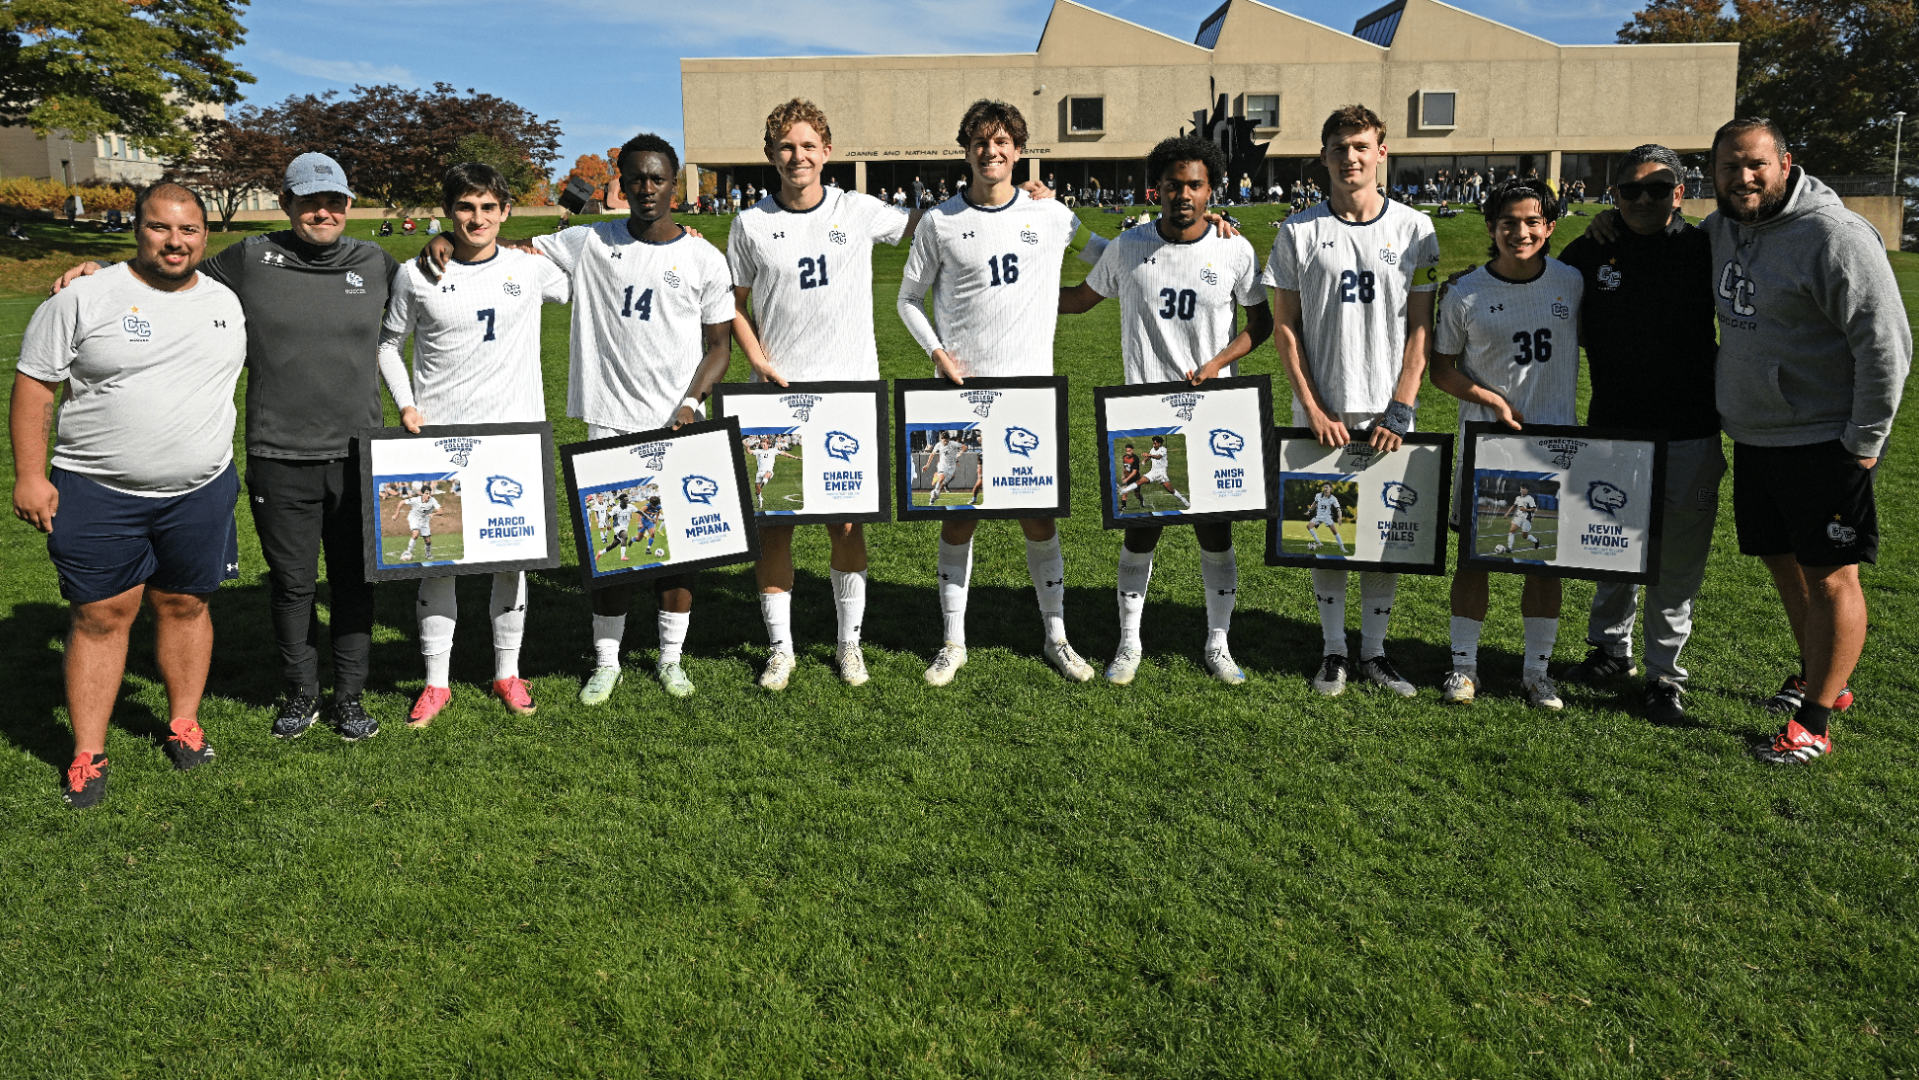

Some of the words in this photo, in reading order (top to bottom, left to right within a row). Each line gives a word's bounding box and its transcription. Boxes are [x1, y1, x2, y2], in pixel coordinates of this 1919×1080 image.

[798, 254, 829, 290] 21
[988, 253, 1019, 287] 16
[1427, 267, 1437, 281] C
[1341, 270, 1375, 304] 28
[621, 285, 653, 321] 14
[1159, 287, 1197, 321] 30
[477, 308, 496, 342] 7
[1512, 328, 1552, 366] 36
[779, 394, 823, 403] CONNECTICUT
[960, 390, 1002, 398] CONNECTICUT
[1161, 393, 1205, 403] CONNECTICUT
[434, 437, 482, 447] CONNECTICUT
[629, 441, 673, 454] CONNECTICUT
[1538, 439, 1588, 448] CONNECTICUT
[823, 471, 863, 481] CHARLIE
[1012, 466, 1033, 476] MAX
[1214, 468, 1244, 479] ANISH
[825, 481, 862, 491] EMERY
[992, 475, 1053, 487] HABERMAN
[1217, 478, 1242, 489] REID
[488, 516, 525, 527] MARCO
[691, 512, 721, 526] GAVIN
[685, 522, 731, 539] MPIANA
[1377, 520, 1419, 531] CHARLIE
[1588, 523, 1623, 536] KEVIN
[479, 525, 535, 539] PERUGINI
[1380, 530, 1414, 542] MILES
[1581, 534, 1629, 549] HWONG
